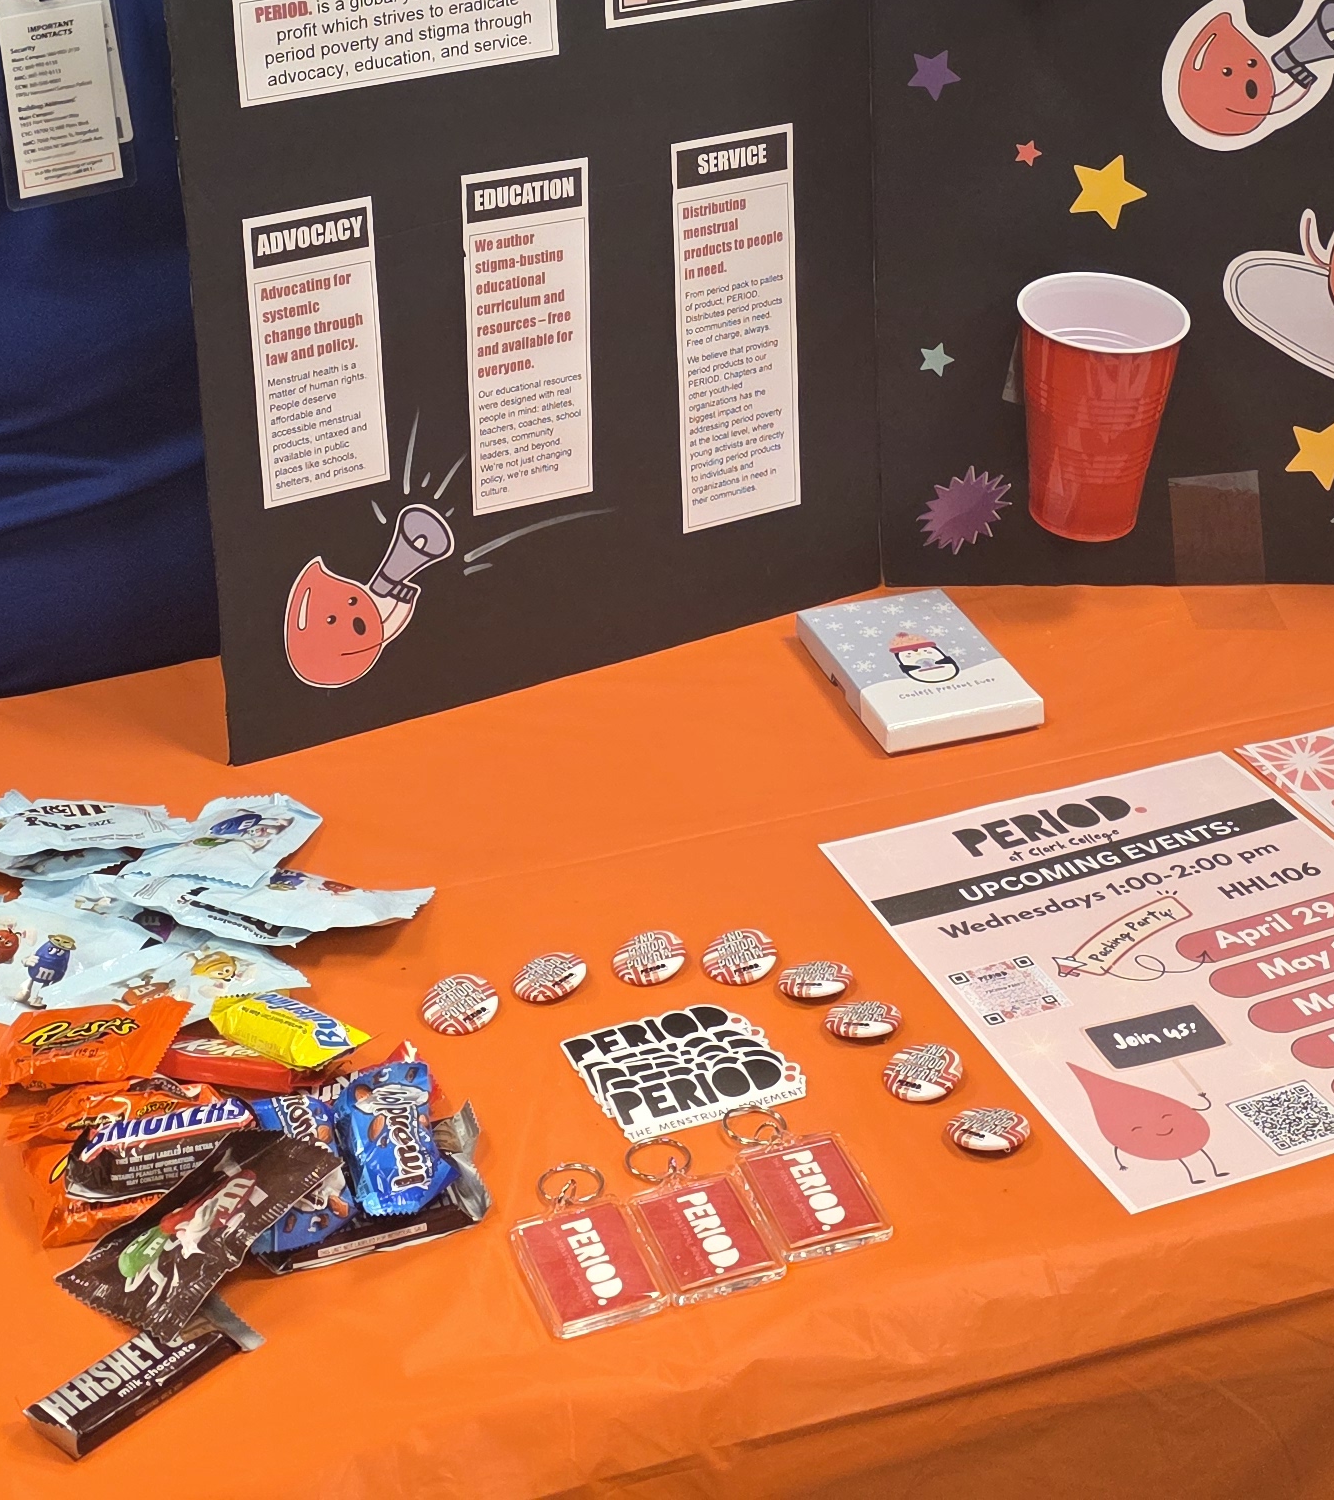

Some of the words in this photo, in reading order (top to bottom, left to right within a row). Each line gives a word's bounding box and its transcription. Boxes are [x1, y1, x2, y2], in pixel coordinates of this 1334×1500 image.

[27, 19, 74, 34] IMPORTANT
[255, 0, 312, 23] PERIOD.
[316, 0, 330, 14] is
[335, 0, 344, 11] a
[276, 22, 317, 45] profit
[321, 14, 368, 34] which
[373, 9, 424, 26] strives
[429, 4, 443, 18] to
[30, 28, 73, 41] CONTACTS
[265, 43, 314, 67] period
[320, 35, 378, 59] poverty
[384, 28, 413, 46] and
[418, 23, 469, 41] stigma
[474, 10, 531, 31] through
[268, 63, 348, 86] advocacy,
[354, 49, 435, 72] education,
[441, 40, 468, 58] and
[474, 34, 531, 52] service.
[697, 143, 767, 175] SERVICE
[474, 176, 575, 212] EDUCATION
[257, 215, 363, 257] ADVOCACY
[474, 239, 493, 252] We
[496, 233, 535, 249] author
[475, 249, 563, 274] stigma-busting
[261, 277, 330, 301] Advocating
[333, 273, 351, 286] for
[476, 271, 545, 295] educational
[262, 300, 320, 323] systemic
[476, 295, 541, 316] curriculum
[543, 289, 564, 304] and
[264, 325, 311, 344] change
[313, 313, 363, 334] through
[477, 316, 536, 337] resources
[547, 310, 571, 324] free
[265, 351, 288, 366] law
[290, 344, 314, 361] and
[316, 337, 358, 357] policy.
[477, 341, 499, 357] and
[501, 333, 554, 353] available
[556, 330, 573, 343] for
[477, 358, 534, 378] everyone.
[952, 796, 1147, 857] PERIOD.
[1009, 851, 1025, 862] at
[1028, 842, 1068, 857] Clark
[1068, 829, 1120, 846] College
[958, 850, 1121, 902] UPCOMING
[1121, 821, 1241, 860] EVENTS:
[937, 891, 1106, 939] Wednesdays
[1106, 853, 1233, 896] 1:00-2:00
[1237, 844, 1280, 864] pm
[1217, 862, 1321, 900] HHL106
[1215, 913, 1293, 949] April
[1292, 901, 1334, 926] 29
[1088, 932, 1136, 963] Packing
[1257, 950, 1331, 979] May
[19, 1018, 139, 1046] Reese's
[1113, 1032, 1162, 1050] Join
[1163, 1022, 1197, 1040] us!
[84, 1097, 247, 1154] SNICKERS
[782, 1150, 846, 1232] PERIOD.
[677, 1191, 740, 1275] PERIOD.
[560, 1218, 624, 1307] PERIOD.
[117, 1379, 143, 1398] milk
[144, 1342, 197, 1380] chocolate
